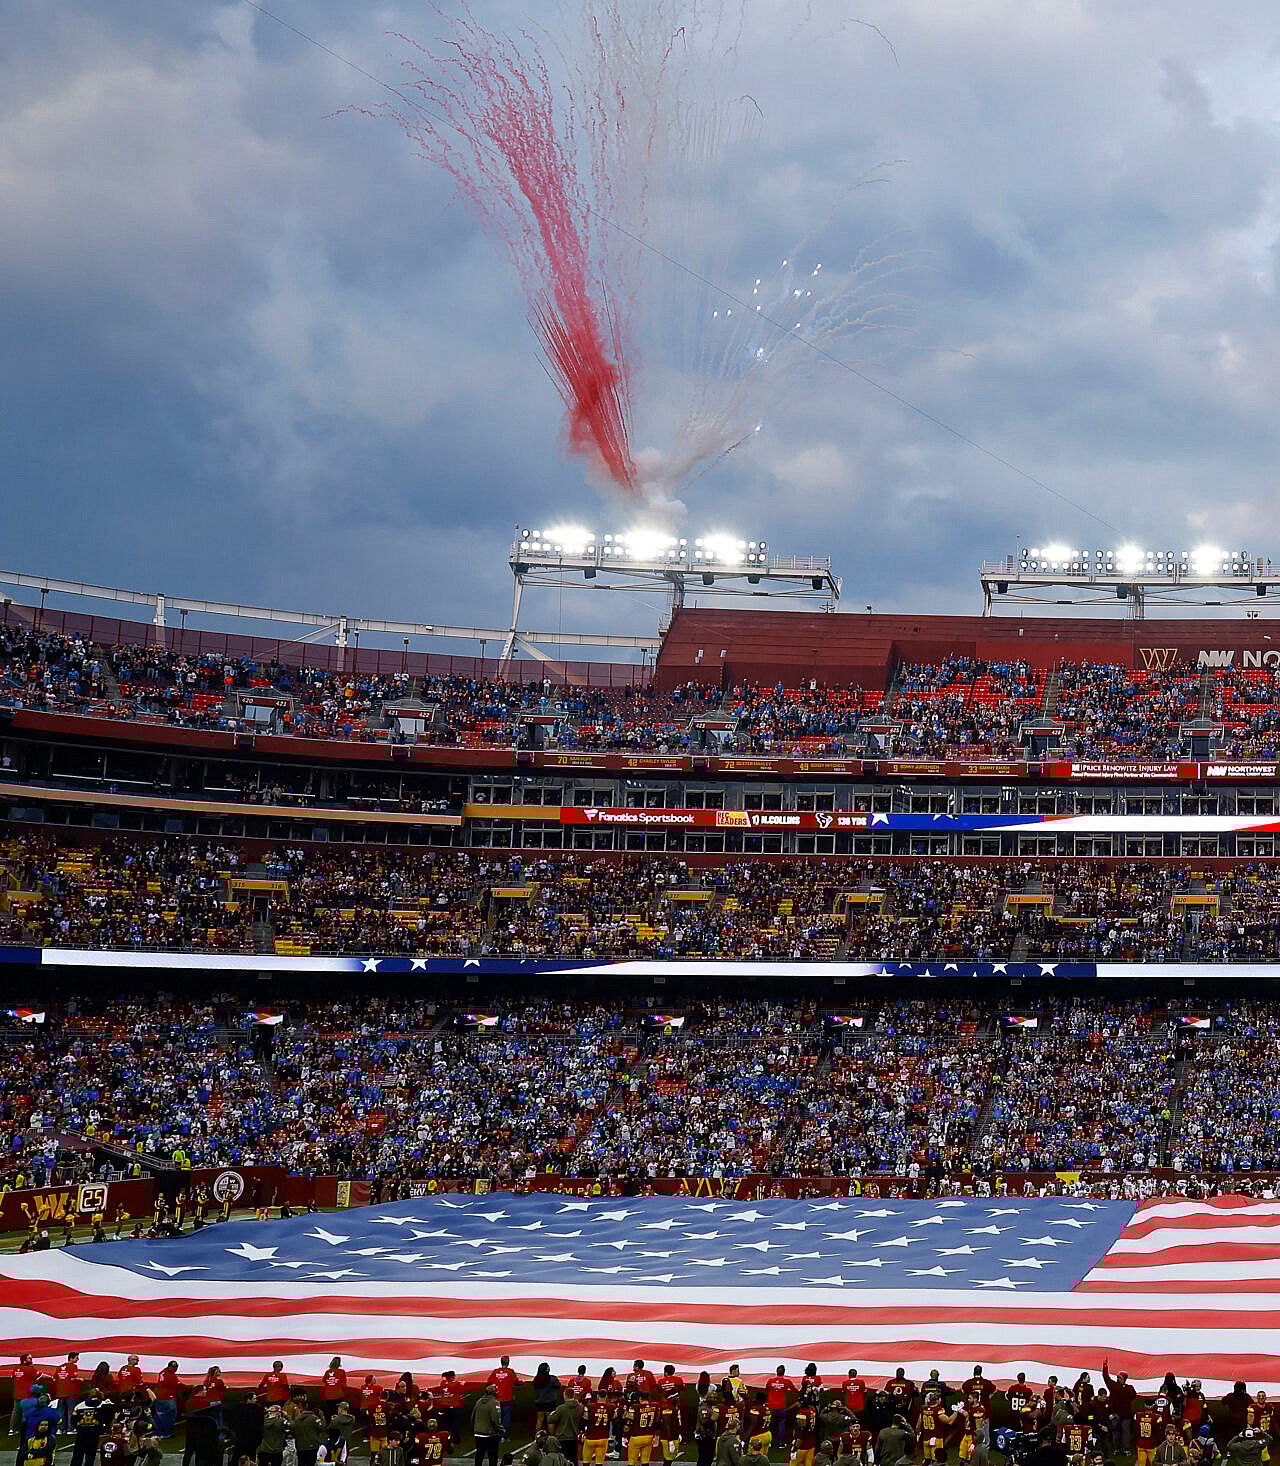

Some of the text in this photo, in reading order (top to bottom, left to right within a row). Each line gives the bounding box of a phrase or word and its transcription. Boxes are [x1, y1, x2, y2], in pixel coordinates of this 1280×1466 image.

[1083, 764, 1178, 773] PRICE BENOWITZ INJURY LAW
[1228, 765, 1278, 773] NORTHWEST
[599, 811, 695, 825] Fanatics Sportsbook
[718, 816, 748, 826] LEADERS
[84, 1189, 103, 1207] 25
[639, 1412, 655, 1428] 67
[424, 1443, 442, 1460] 78
